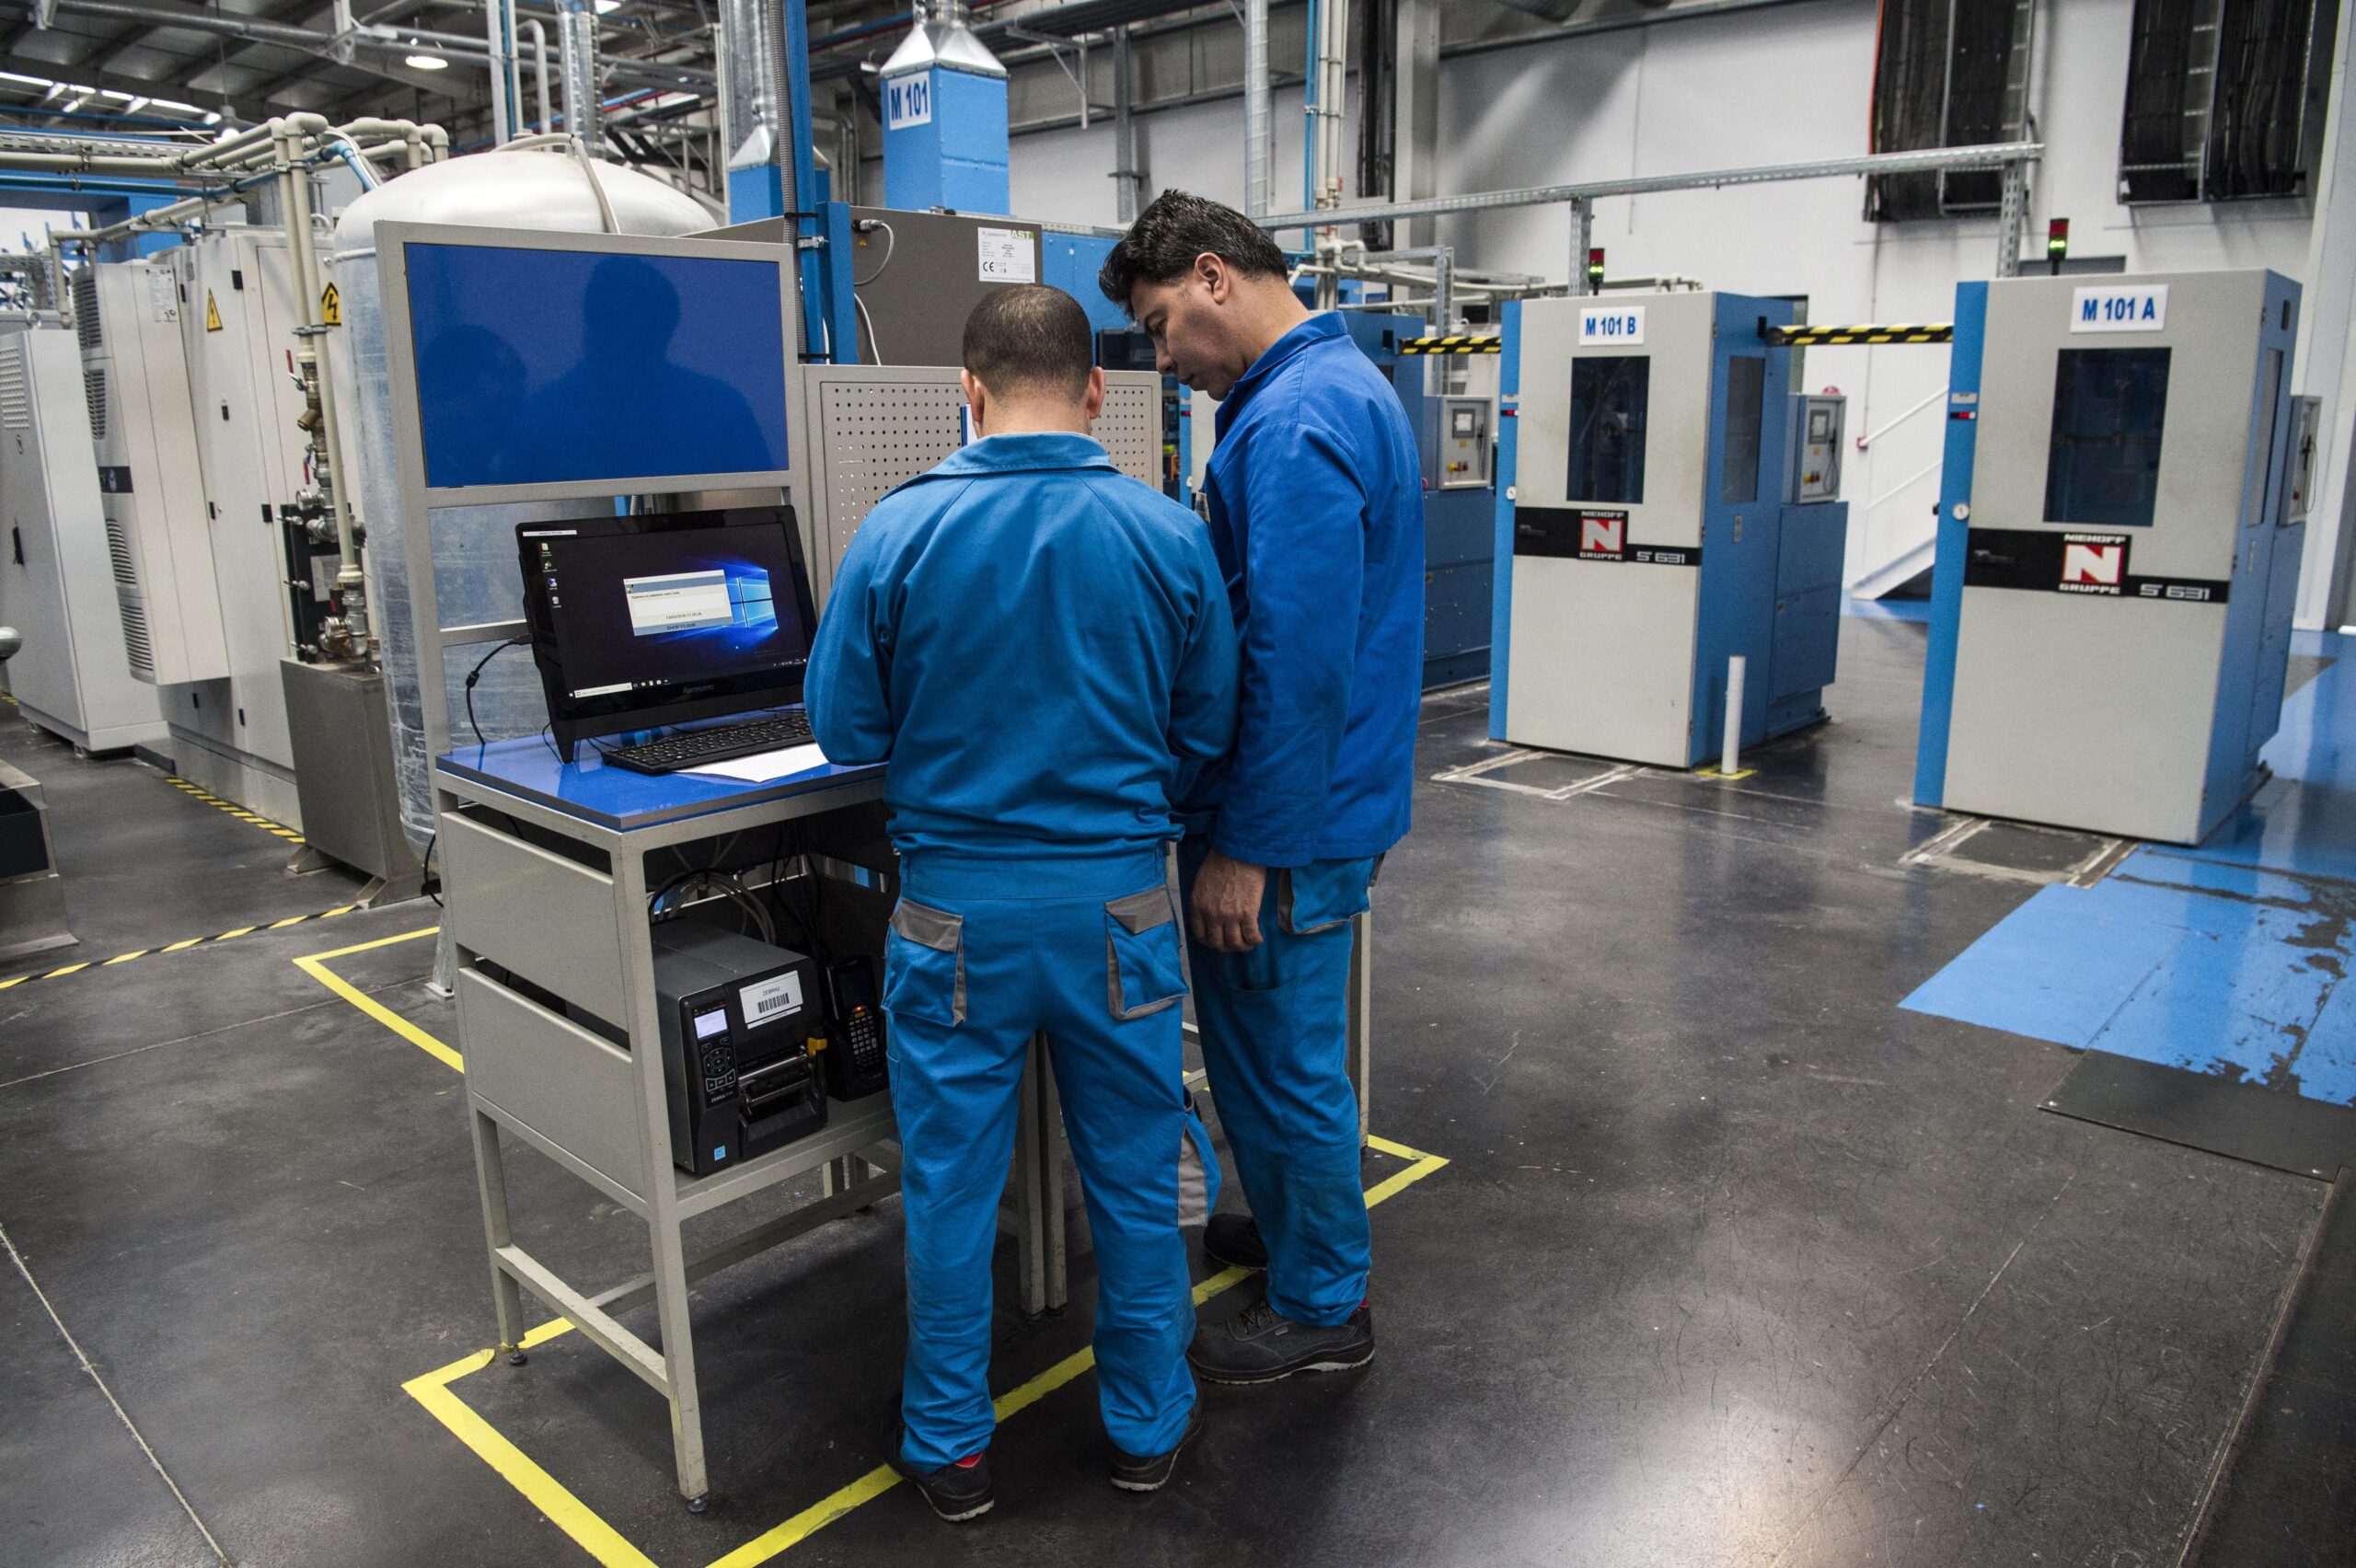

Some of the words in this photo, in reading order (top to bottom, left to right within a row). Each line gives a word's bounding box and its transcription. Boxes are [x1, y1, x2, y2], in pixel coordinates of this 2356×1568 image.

[891, 86, 902, 121] M
[907, 79, 928, 117] 101
[1011, 230, 1033, 239] AST
[2083, 299, 2098, 321] M
[2105, 297, 2135, 320] 101
[2142, 296, 2155, 320] A
[1586, 317, 1596, 336] M
[1600, 317, 1622, 336] 101
[1627, 316, 1636, 335] B
[1581, 511, 1624, 519] NIEHOFF
[2063, 533, 2127, 545] NIEHOFF
[1579, 551, 1623, 560] GRUPPE
[1655, 552, 1686, 564] 631
[2062, 545, 2122, 584] N
[2059, 582, 2121, 595] GRUPPE
[2165, 585, 2211, 601] 631
